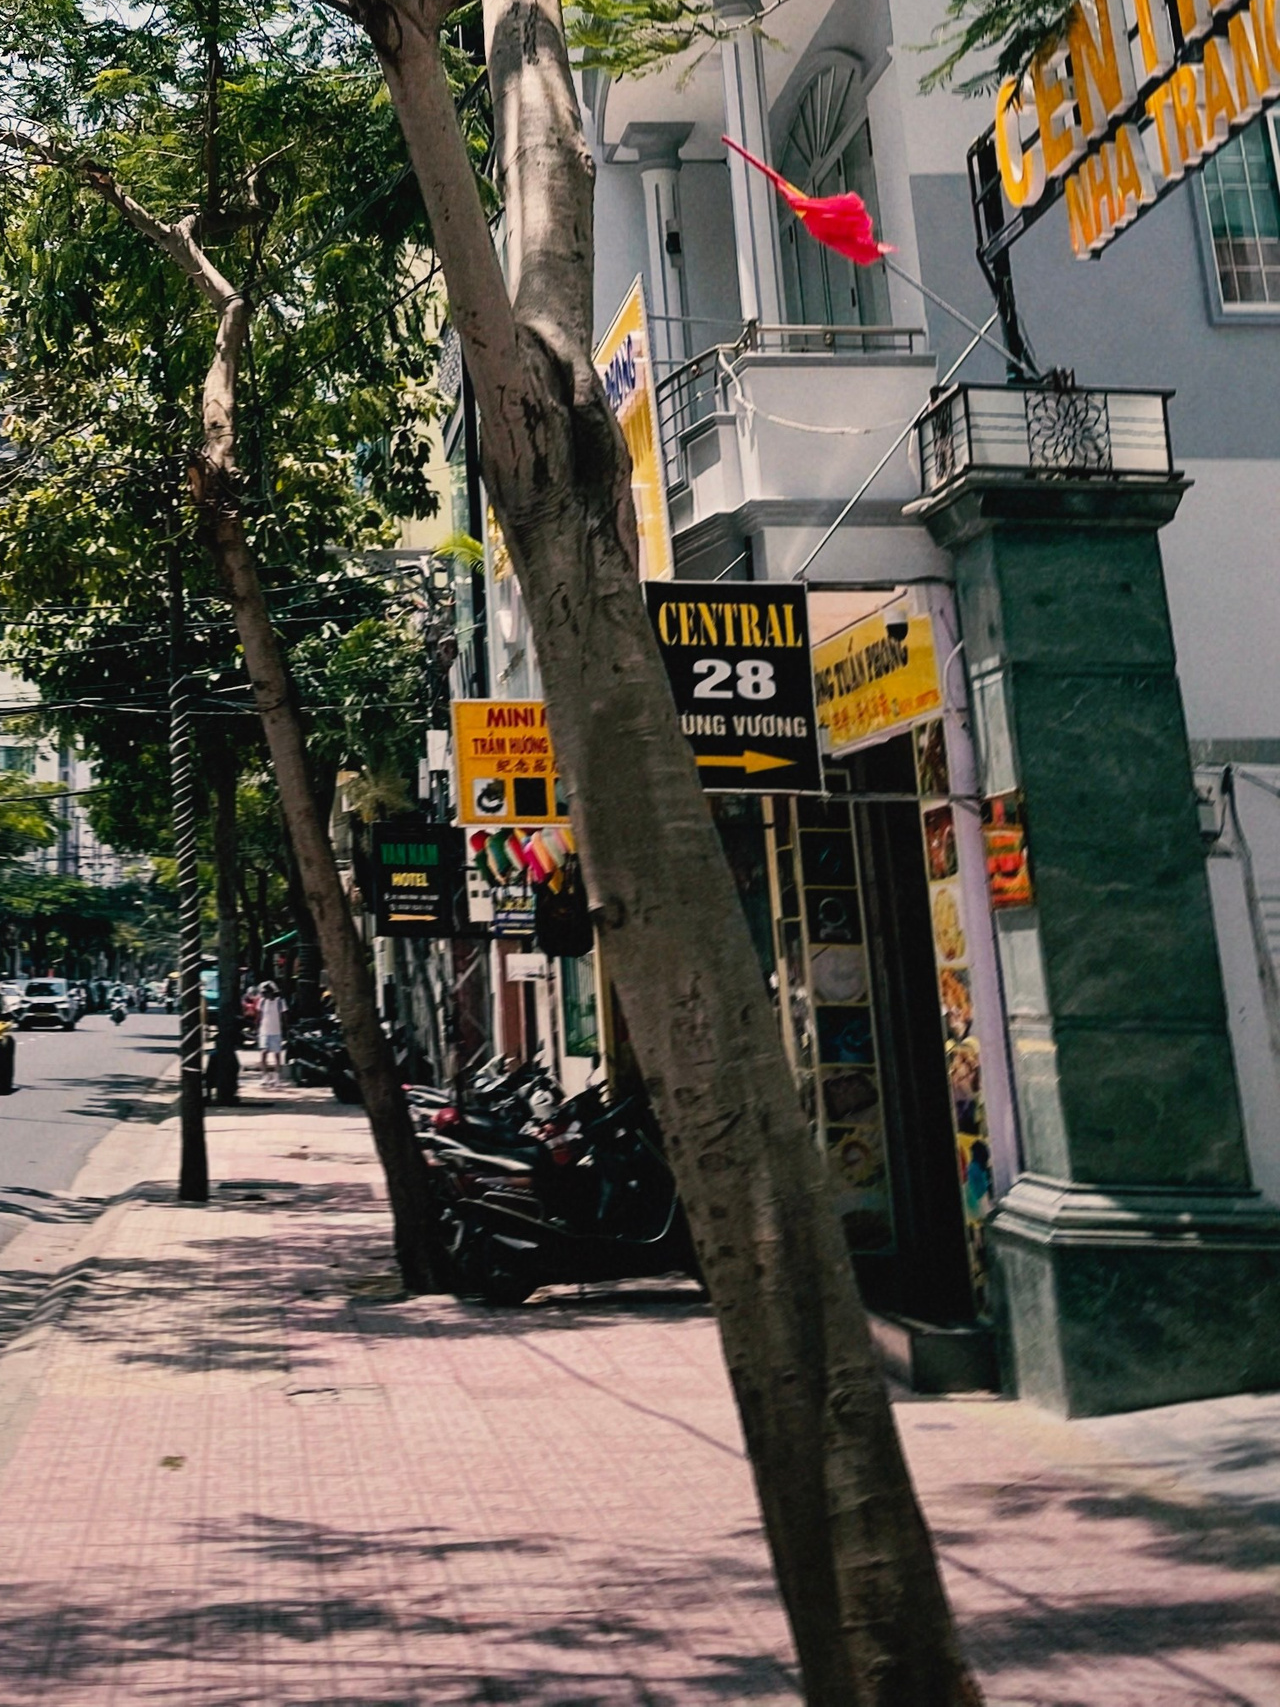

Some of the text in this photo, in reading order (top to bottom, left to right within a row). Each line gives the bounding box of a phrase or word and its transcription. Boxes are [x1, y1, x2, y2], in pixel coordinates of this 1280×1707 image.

[1064, 124, 1157, 260] NHA
[658, 601, 803, 648] CENTRAL
[692, 658, 777, 700] 28
[486, 708, 535, 728] MINI
[732, 714, 808, 738] VƯƠNG
[391, 872, 430, 887] HOTEL
